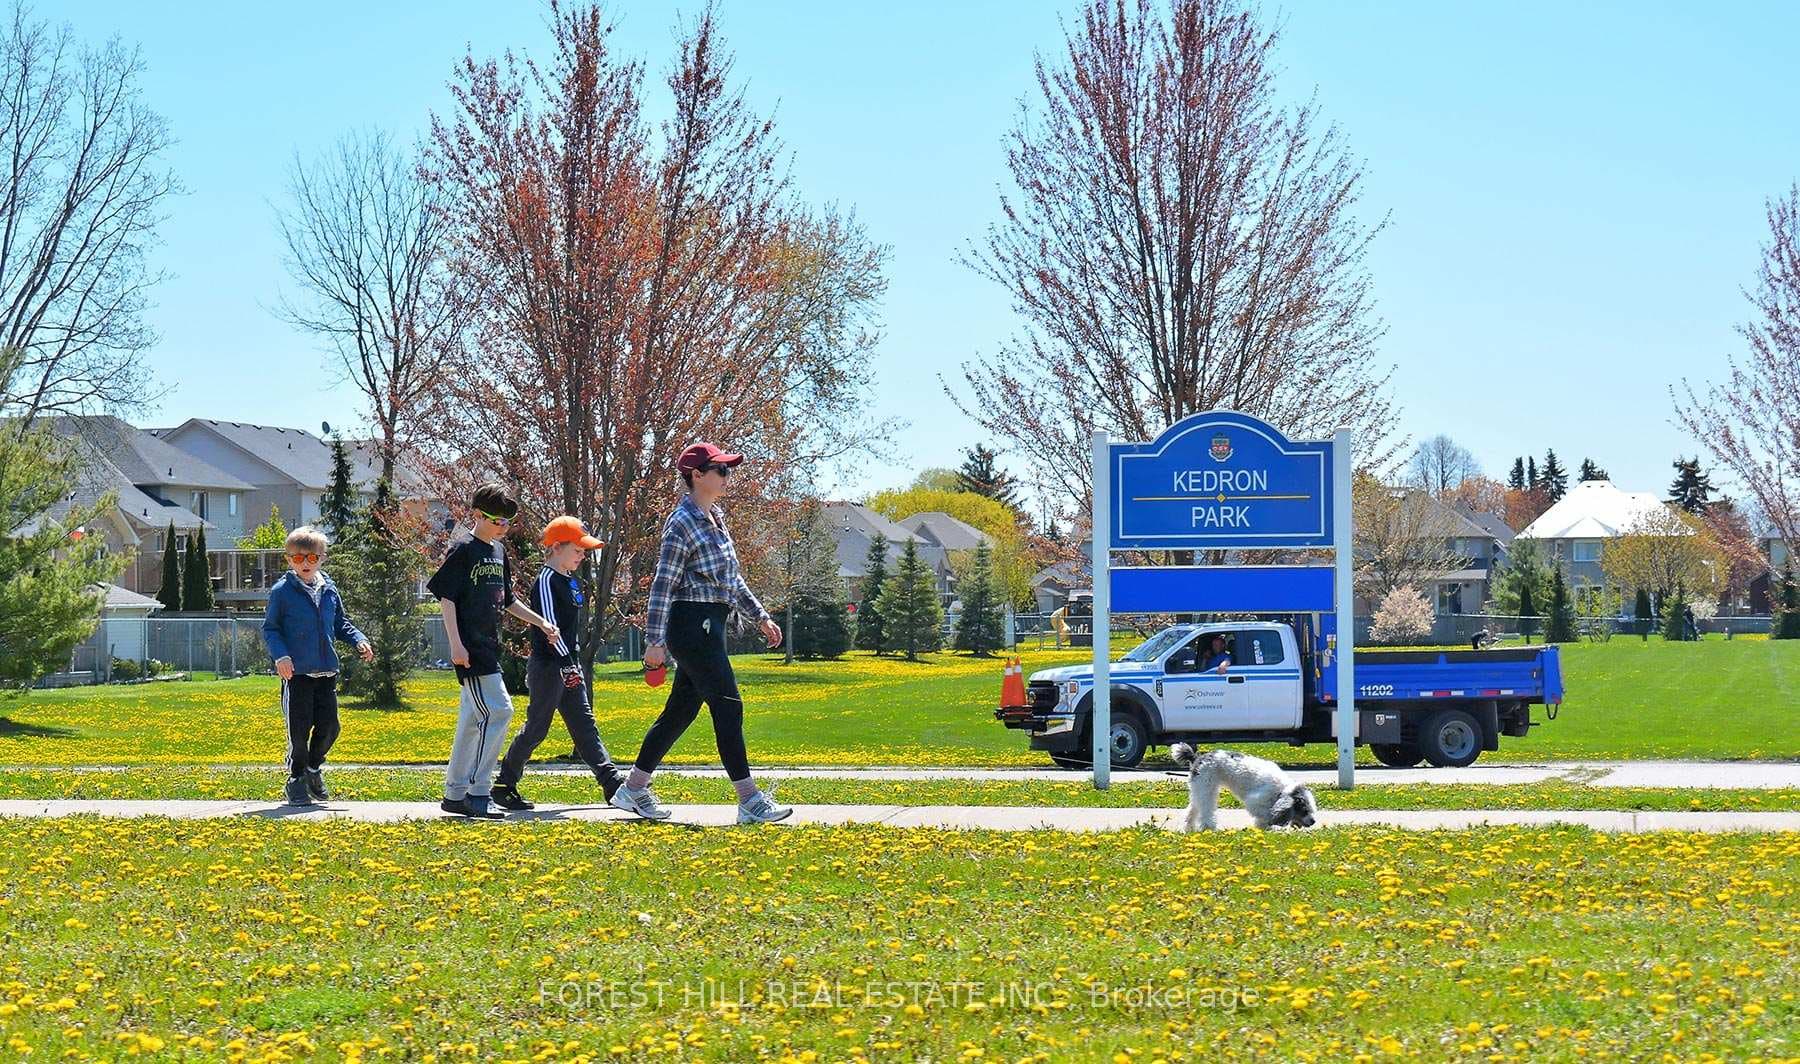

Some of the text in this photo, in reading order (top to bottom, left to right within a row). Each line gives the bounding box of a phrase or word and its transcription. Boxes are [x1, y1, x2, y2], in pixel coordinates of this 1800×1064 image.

[1173, 469, 1267, 492] KEDRON
[1191, 505, 1251, 528] PARK
[1360, 684, 1394, 697] 11202
